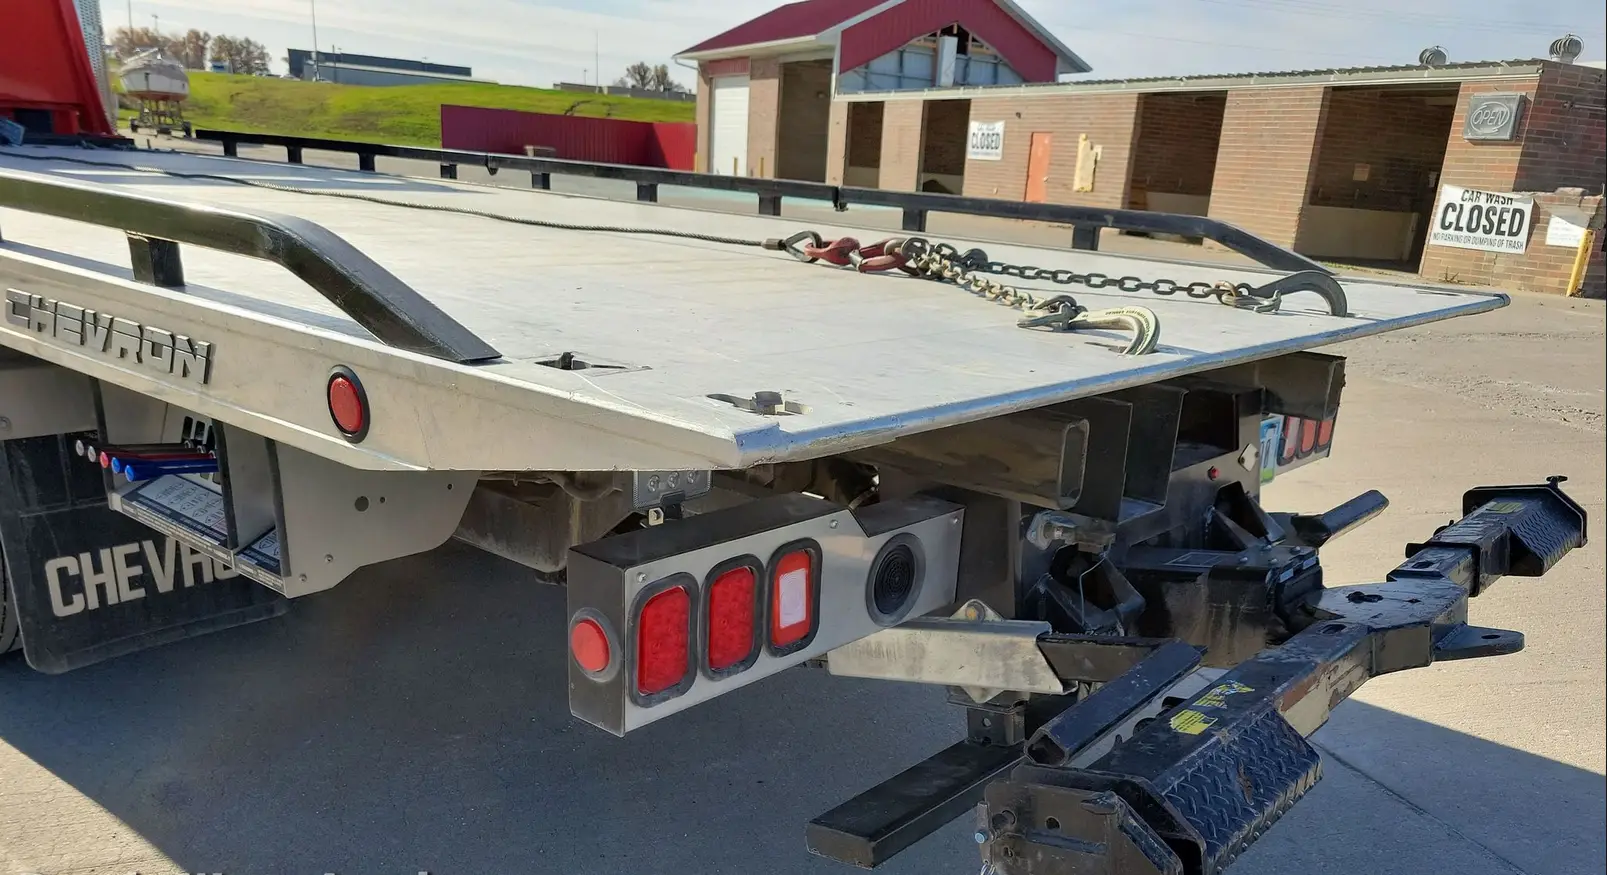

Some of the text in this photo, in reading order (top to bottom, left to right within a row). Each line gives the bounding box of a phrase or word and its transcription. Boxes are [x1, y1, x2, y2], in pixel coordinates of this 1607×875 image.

[1473, 109, 1508, 125] OPEN
[972, 132, 1001, 150] CLOSED
[1460, 189, 1482, 202] CAR
[1440, 202, 1525, 237] CLOSED
[1433, 232, 1524, 250] NO PARKING OR DUMPING OF TRASH
[5, 287, 216, 385] CHEVRON
